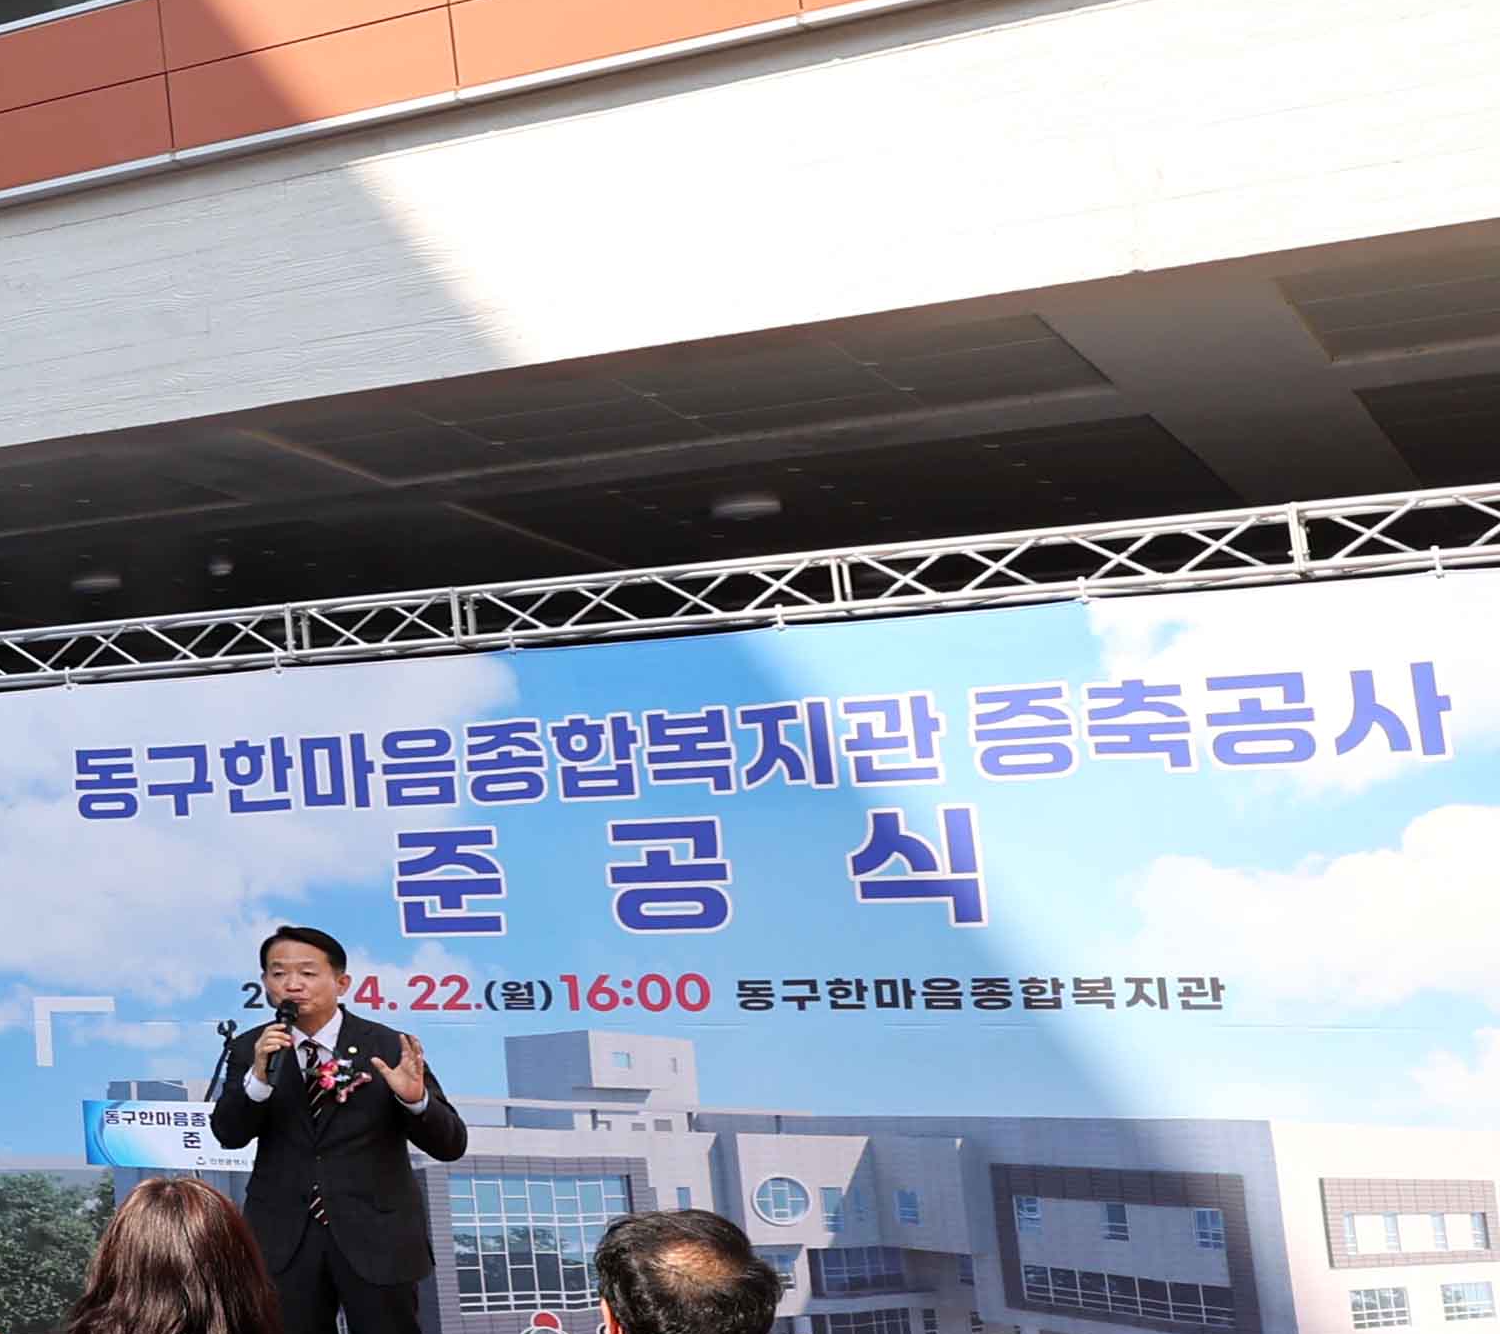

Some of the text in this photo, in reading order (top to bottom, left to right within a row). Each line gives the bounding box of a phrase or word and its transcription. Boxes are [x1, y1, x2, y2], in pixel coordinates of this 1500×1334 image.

[73, 661, 1452, 821] 동구한마음종합복지관 증축공사
[395, 805, 986, 936] 준 공 식
[559, 972, 711, 1013] 16:00
[735, 974, 1226, 1013] 동구한마음종합복지관
[105, 1110, 211, 1128] 동구한마음종
[182, 1130, 202, 1150] 준
